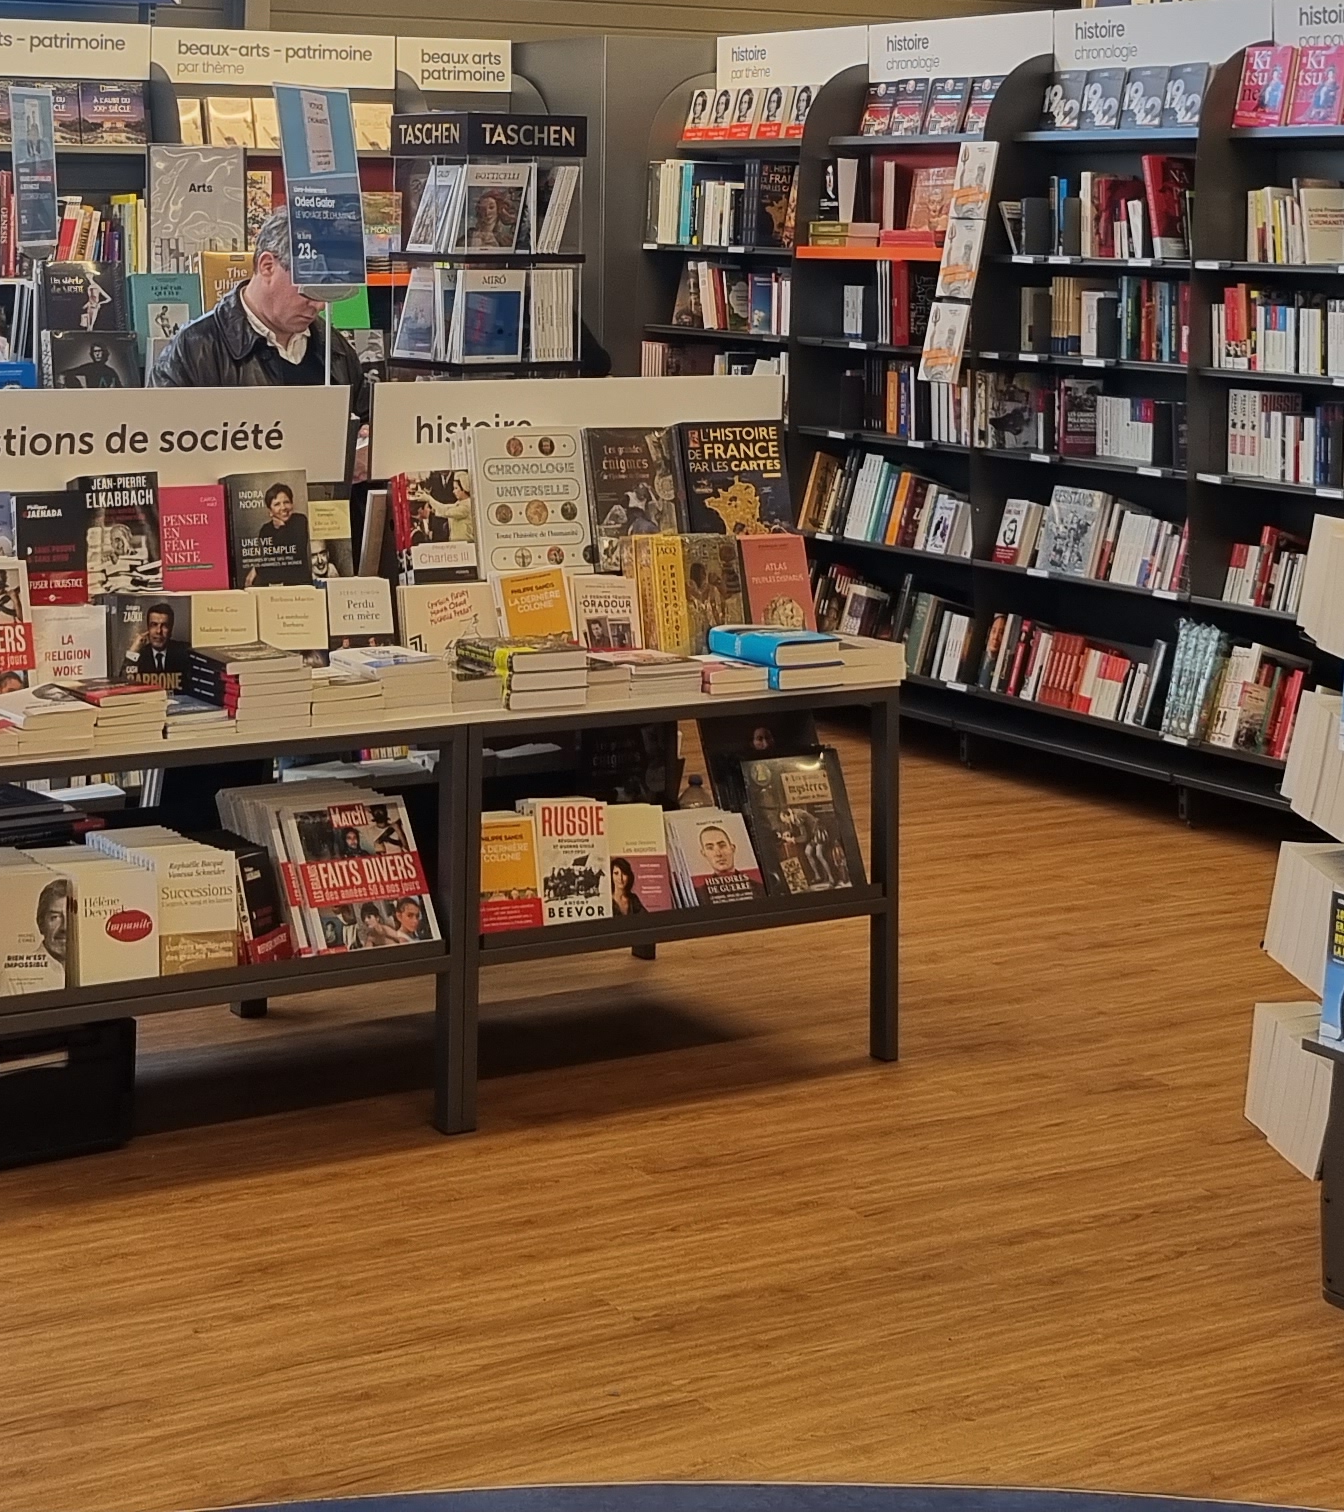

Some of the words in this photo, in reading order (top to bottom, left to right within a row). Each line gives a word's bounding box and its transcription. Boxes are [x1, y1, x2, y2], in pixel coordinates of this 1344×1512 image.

[1074, 20, 1126, 41] histoire
[29, 33, 127, 53] patrimoine
[885, 34, 930, 53] histoire
[177, 39, 271, 60] beaux-arts
[285, 44, 374, 64] patrimoine
[420, 48, 469, 66] beaux
[472, 51, 502, 66] arts
[731, 46, 768, 63] histoire
[1074, 43, 1139, 63] chronologie
[177, 63, 200, 76] par
[203, 61, 245, 76] thème
[886, 54, 941, 73] chronologie
[420, 66, 506, 85] patrimoine
[731, 69, 745, 81] par
[746, 65, 772, 79] thème
[398, 122, 461, 146] TASCHEN
[481, 122, 576, 147] TASCHEN
[188, 182, 213, 194] Arts
[105, 424, 149, 455] de
[159, 420, 284, 453] société
[699, 426, 778, 442] L'HISTOIRE
[688, 449, 703, 461] DE
[703, 441, 780, 460] FRANCE
[487, 462, 576, 476] CHRONOLOGIE
[689, 462, 709, 473] PAR
[711, 461, 729, 472] LES
[730, 460, 782, 472] CARTES
[91, 475, 147, 491] JEAN-PIERRE
[496, 484, 570, 497] UNIVERSELLE
[85, 490, 154, 509] ELKABBACH
[162, 513, 209, 527] PENSER
[163, 527, 180, 539] EN
[241, 538, 259, 547] UNE
[260, 537, 273, 546] VIE
[165, 551, 201, 563] NISTE
[242, 547, 261, 557] BIEN
[262, 545, 297, 556] REMPLIE
[419, 552, 455, 565] Charles
[457, 551, 469, 562] III
[347, 599, 375, 610] Perdu
[517, 601, 555, 614] COLONIE
[342, 612, 355, 621] en
[356, 610, 381, 621] mère
[61, 634, 74, 646] LA
[7, 654, 28, 668] jours
[44, 648, 91, 661] RELIGION
[52, 665, 84, 677] WOKE
[541, 805, 605, 836] RUSSIE
[161, 884, 233, 900] Successions
[547, 903, 605, 919] BEEVOR
